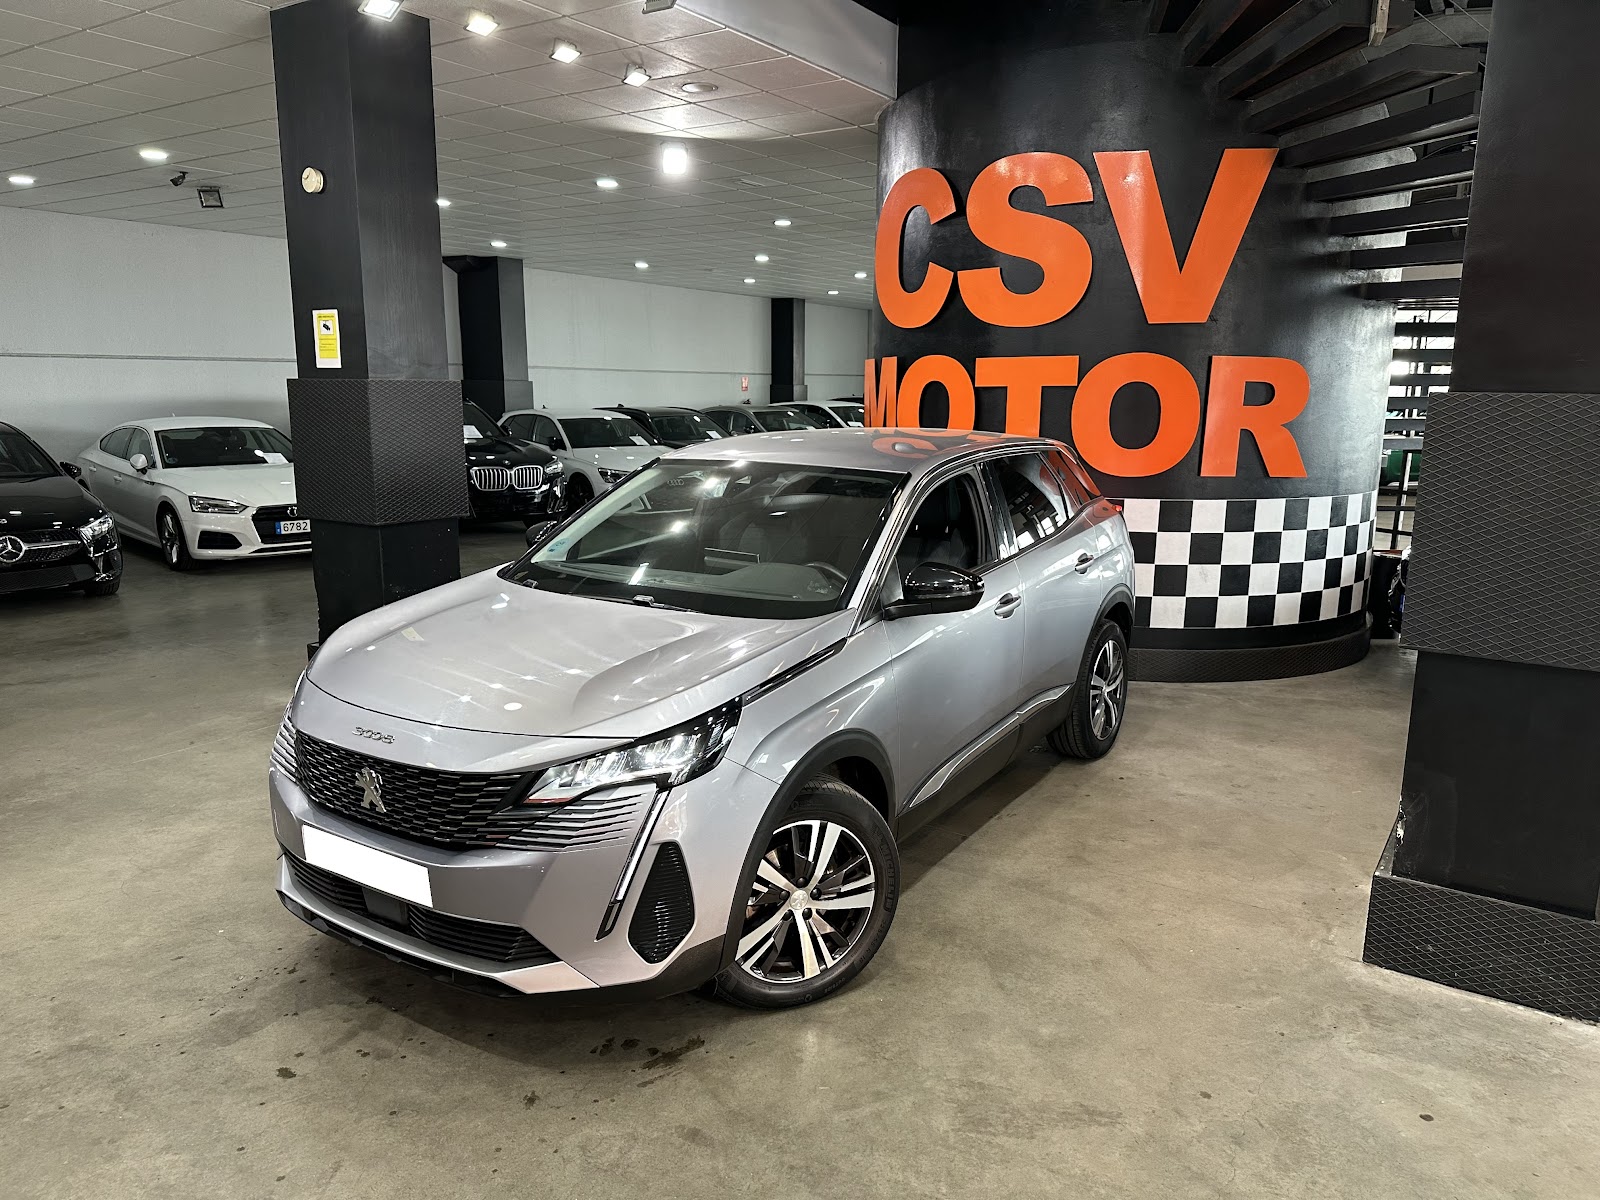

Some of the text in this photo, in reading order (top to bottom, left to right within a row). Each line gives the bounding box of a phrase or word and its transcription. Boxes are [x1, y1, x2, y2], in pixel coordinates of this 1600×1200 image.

[874, 147, 1279, 329] CSV
[864, 351, 1311, 478] MOTOR
[283, 521, 308, 532] 6782
[351, 726, 395, 744] 3008
[880, 842, 895, 911] MICHELIN
